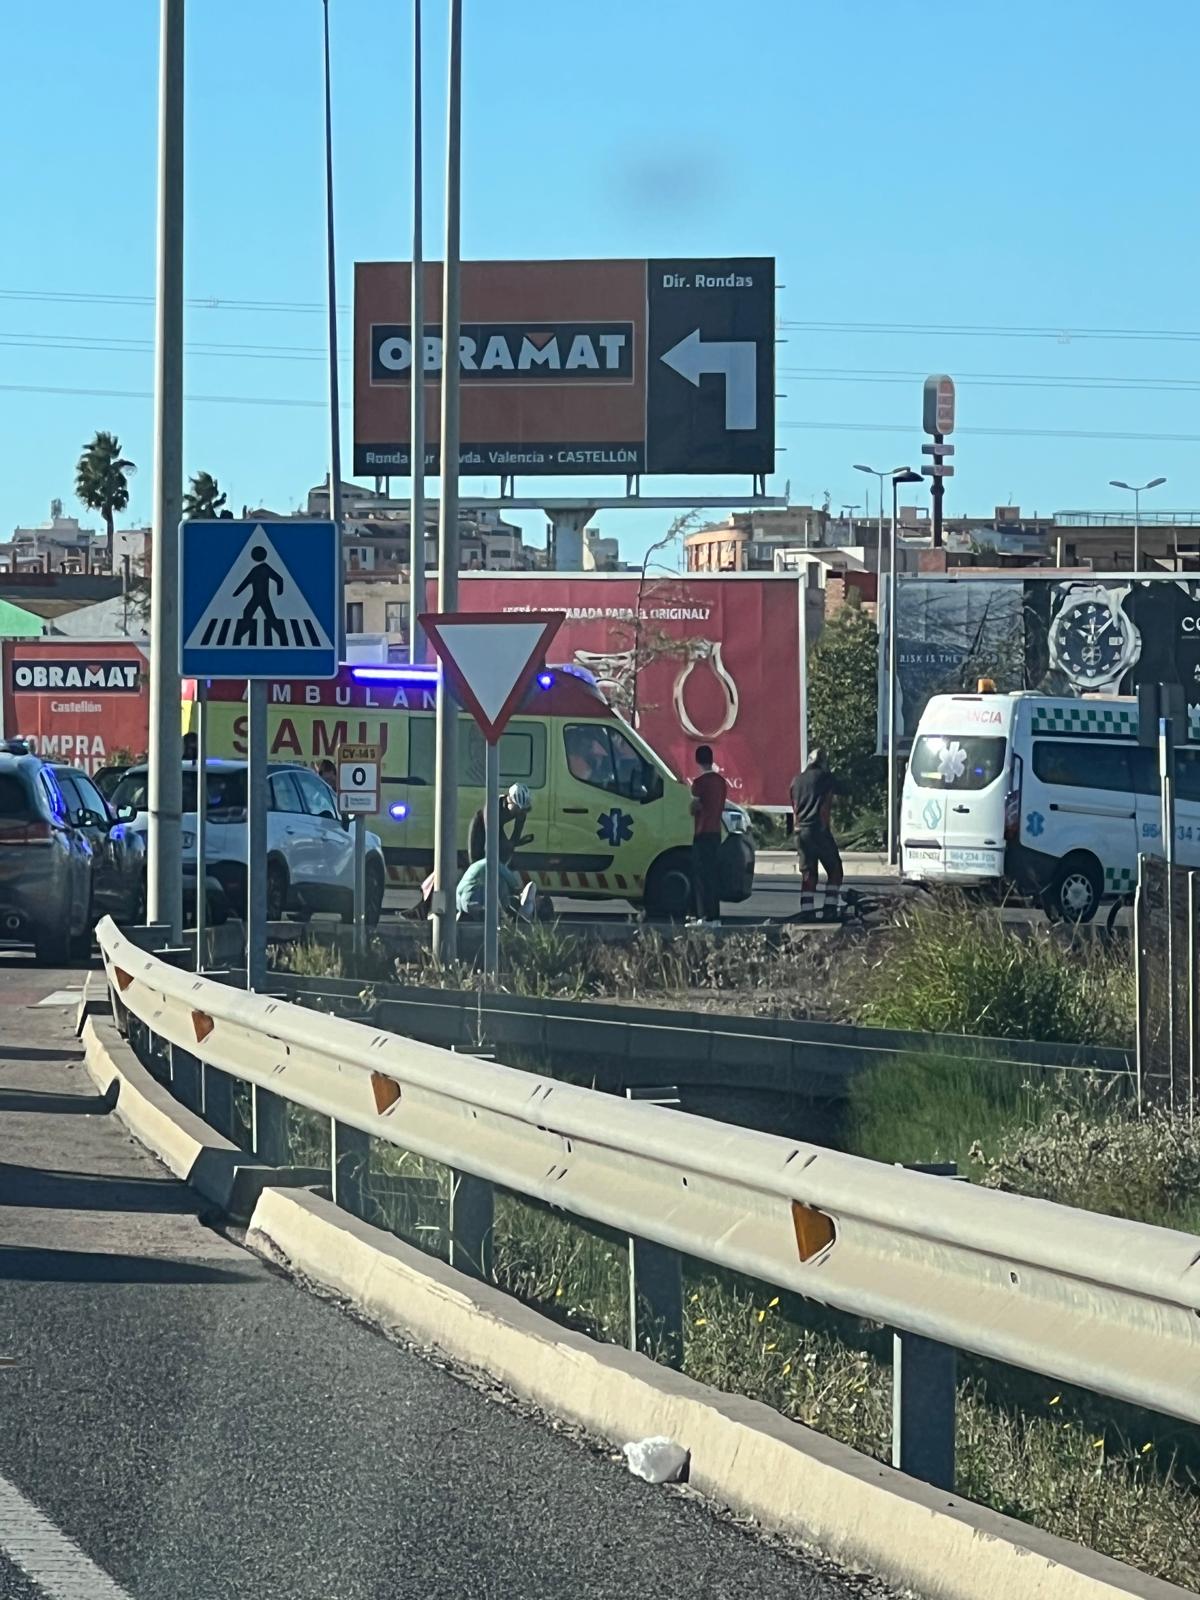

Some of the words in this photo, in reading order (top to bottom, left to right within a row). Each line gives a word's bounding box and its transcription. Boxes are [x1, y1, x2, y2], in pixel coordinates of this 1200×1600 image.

[662, 274, 691, 288] Dir.
[695, 272, 753, 288] Rondas
[378, 332, 626, 371] OBRAMAT
[365, 451, 408, 464] Ronda
[458, 451, 485, 463] vda.
[488, 450, 545, 463] Valencia
[557, 448, 638, 463] CASTELLÓN
[650, 607, 711, 621] ORIGINAL?
[15, 665, 138, 688] OBRAMAT
[16, 733, 106, 756] OMPRA
[232, 714, 389, 757] SAMU
[352, 767, 366, 786] 0
